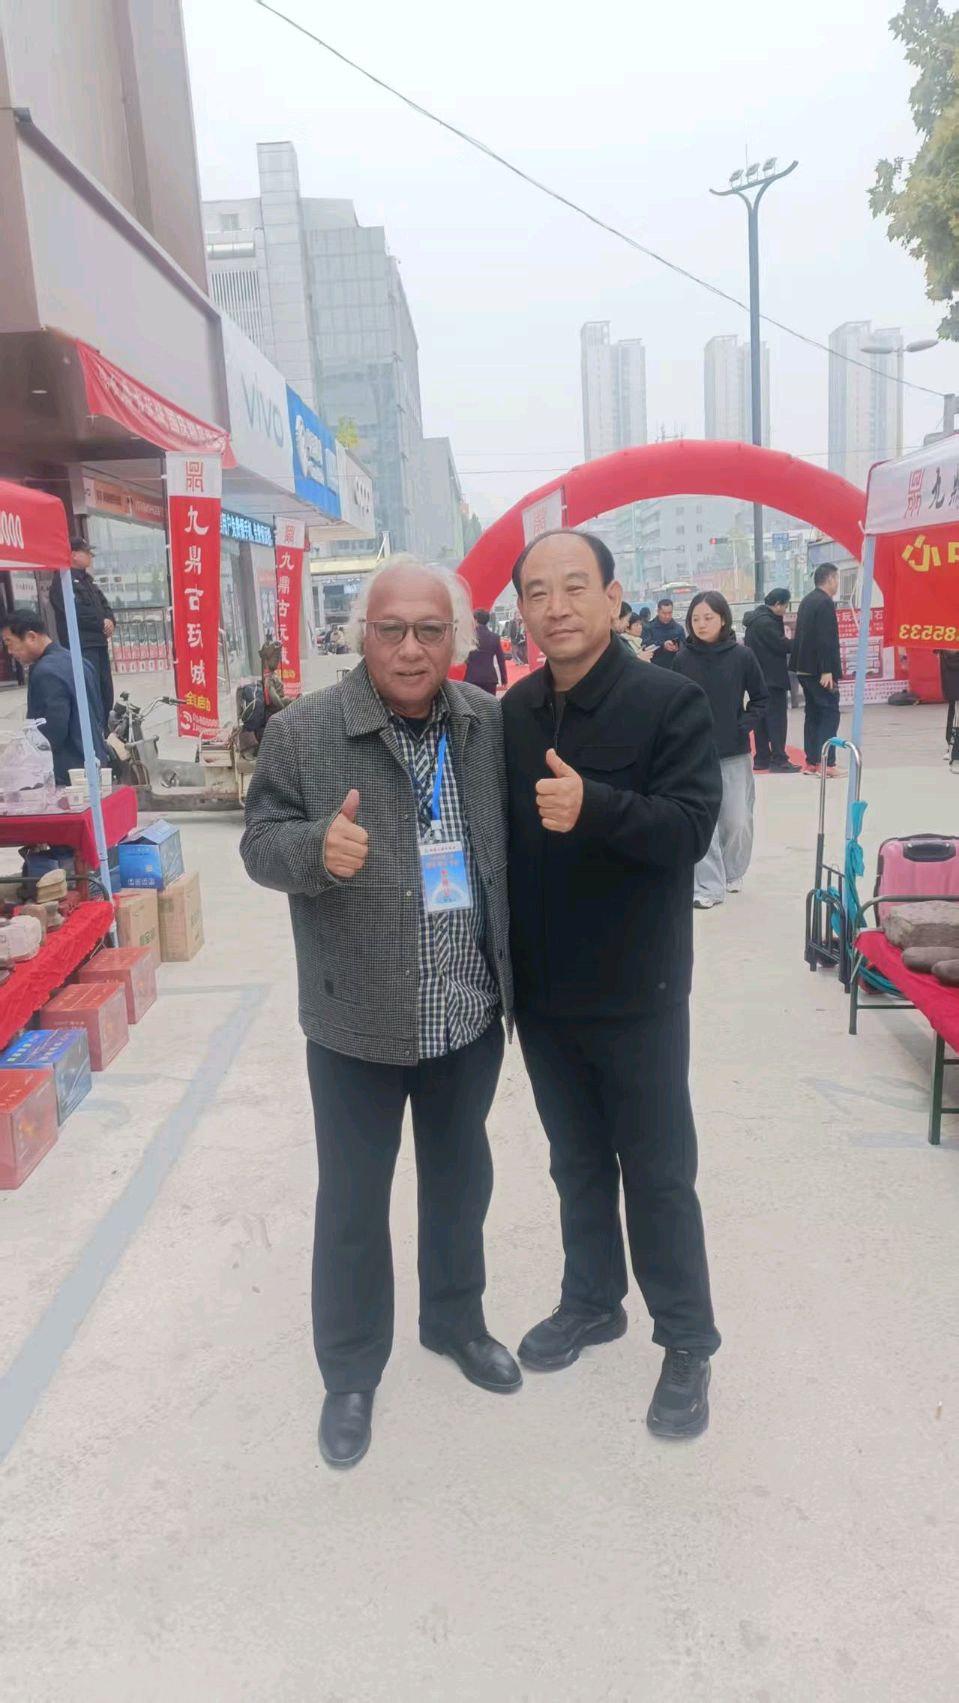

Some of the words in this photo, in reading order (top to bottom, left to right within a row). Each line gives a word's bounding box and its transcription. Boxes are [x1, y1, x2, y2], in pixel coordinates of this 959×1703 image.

[184, 504, 209, 689] 九鼎古玩城
